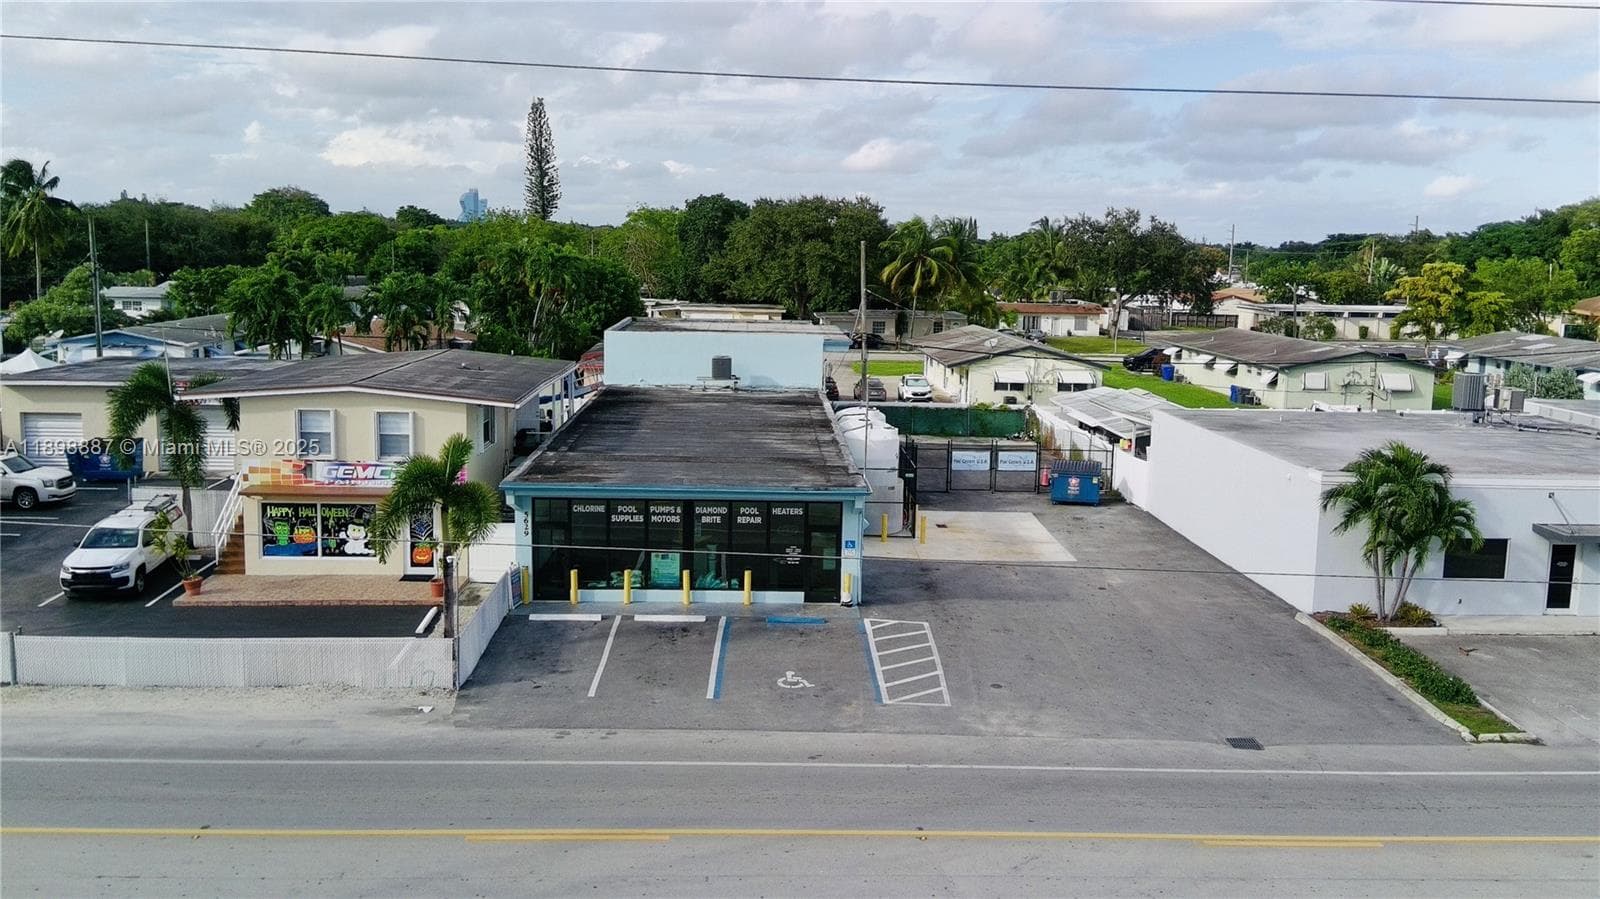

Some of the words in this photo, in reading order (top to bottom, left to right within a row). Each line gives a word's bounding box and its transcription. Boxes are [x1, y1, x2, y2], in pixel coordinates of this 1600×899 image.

[323, 465, 397, 479] GEMC
[266, 505, 293, 518] HAPPY
[573, 505, 605, 513] CHLORINE
[740, 507, 759, 515] POOL
[772, 507, 804, 515] HEATERS
[701, 516, 721, 524] BRITE
